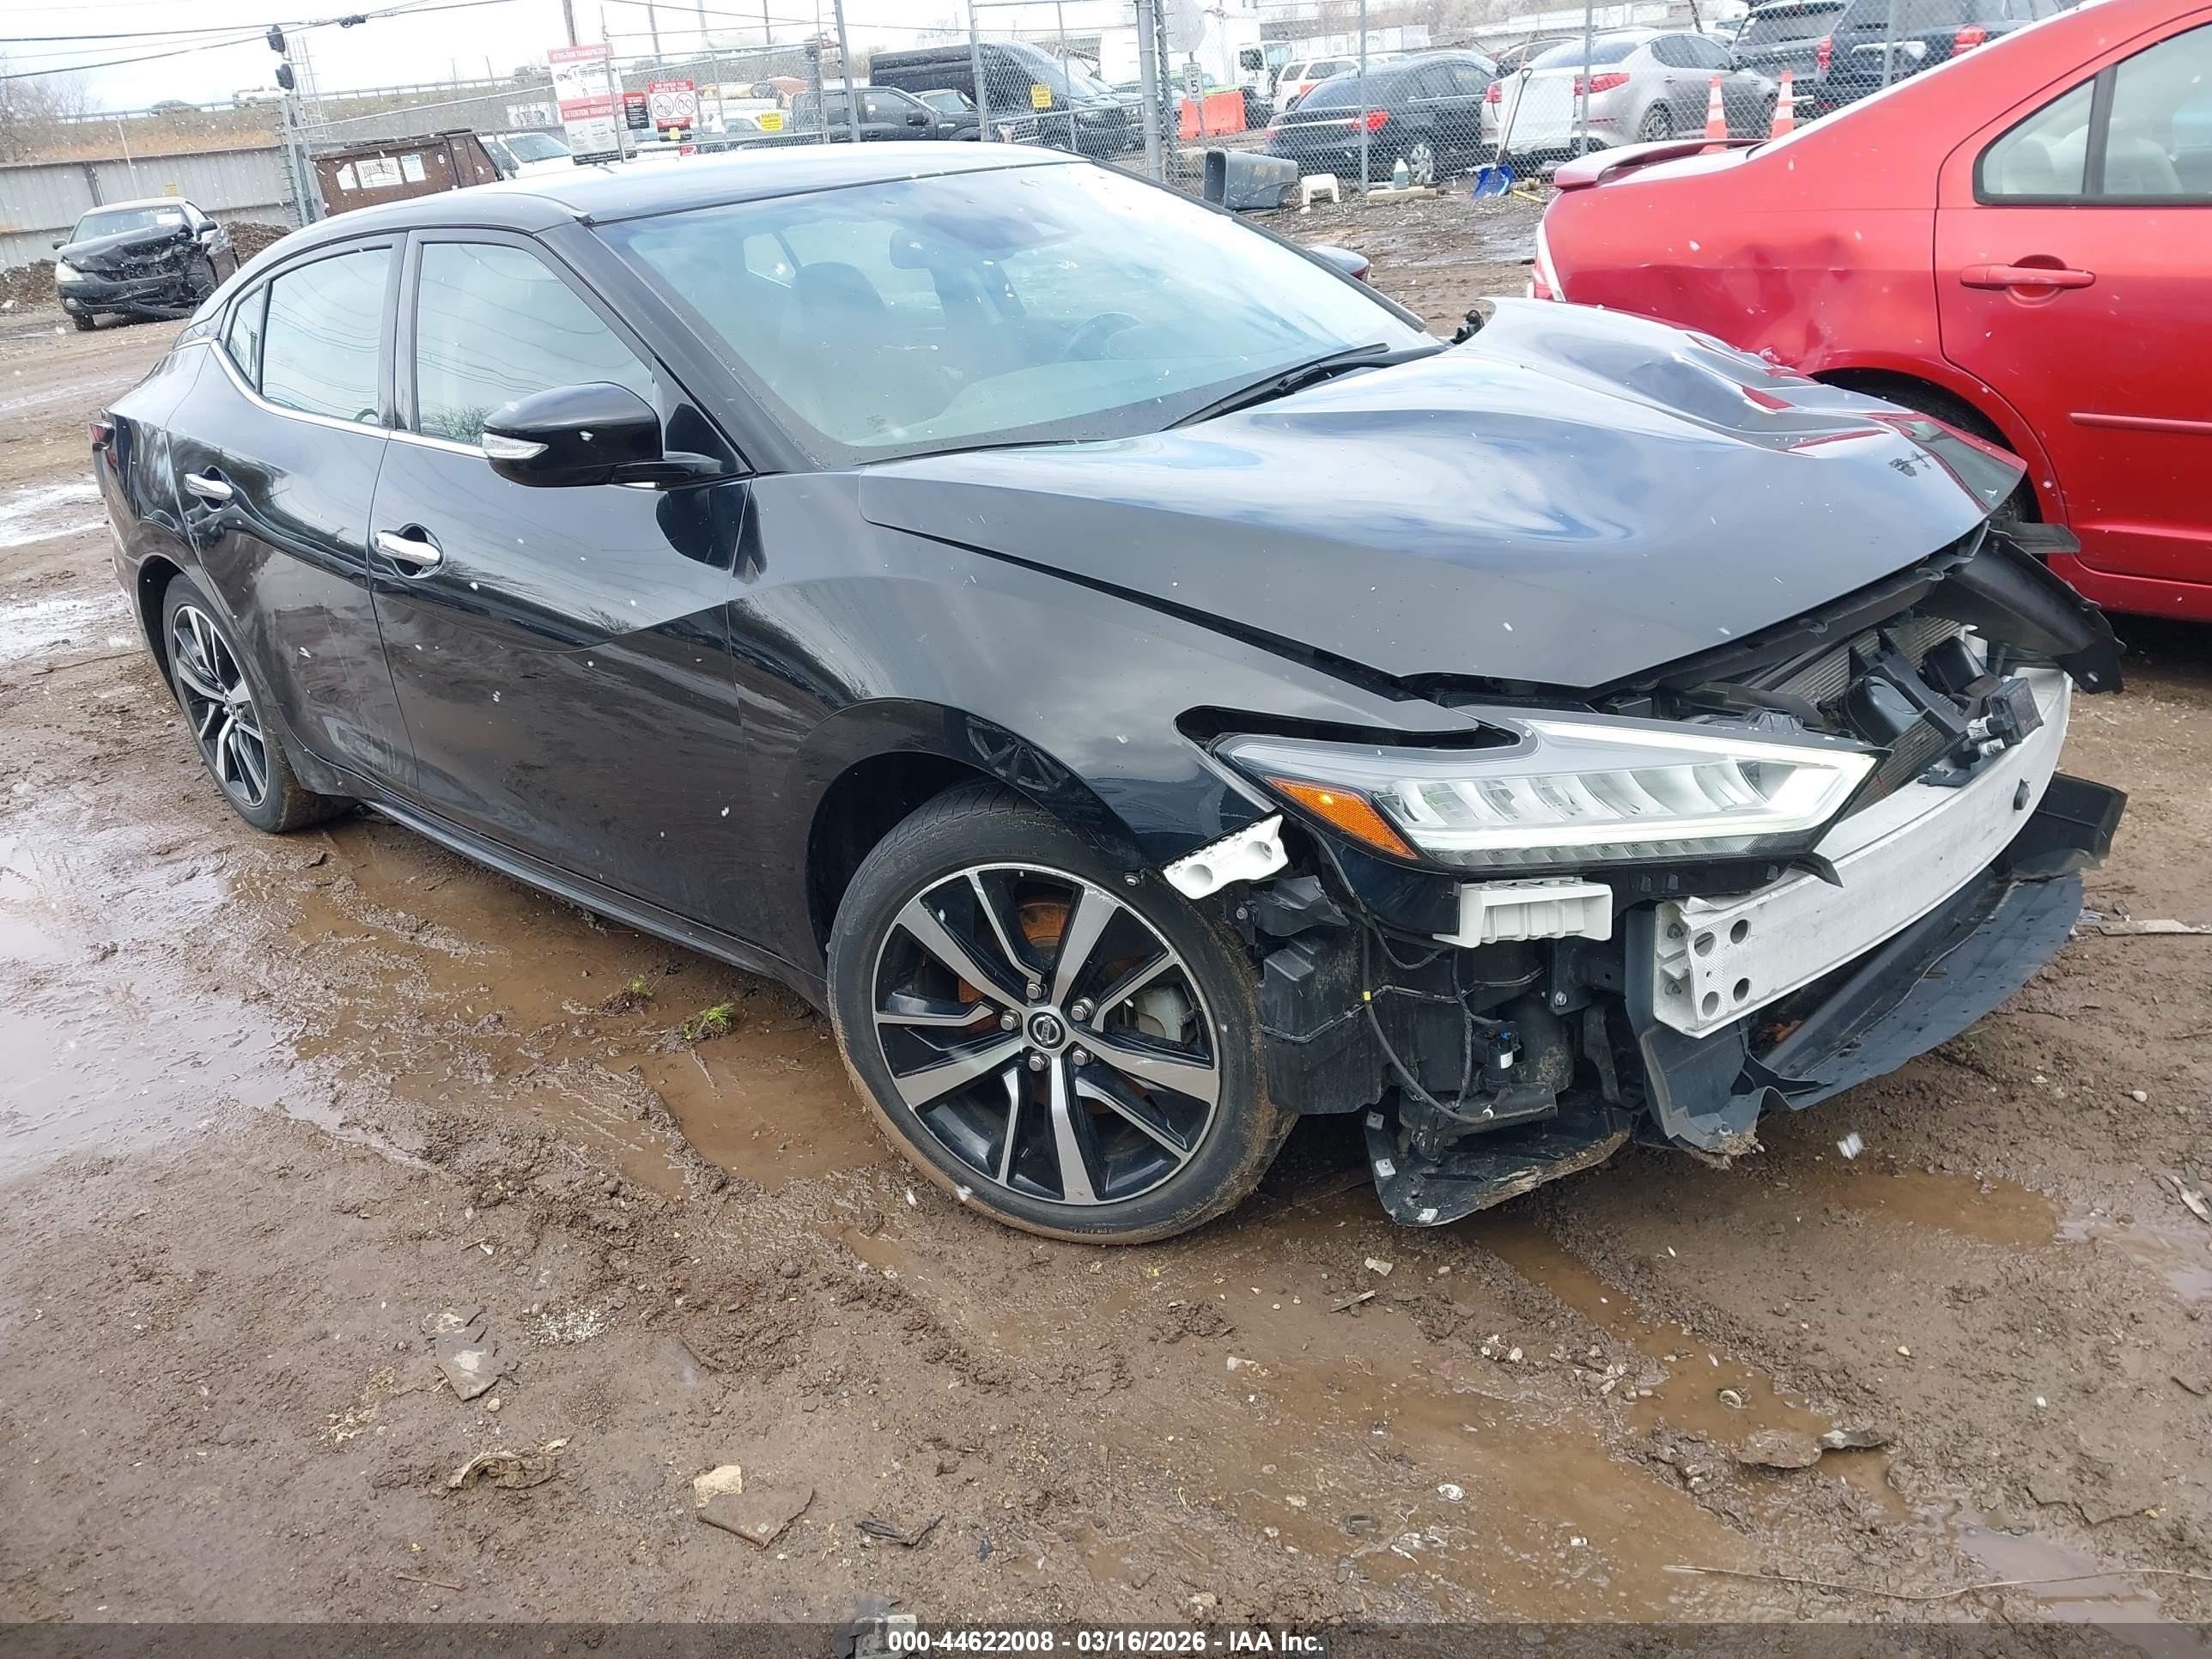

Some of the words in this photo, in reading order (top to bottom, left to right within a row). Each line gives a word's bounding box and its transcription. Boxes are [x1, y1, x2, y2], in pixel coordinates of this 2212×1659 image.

[1191, 79, 1199, 94] 5
[564, 107, 589, 118] ATTENTION
[1041, 1017, 1052, 1045] NISSAN
